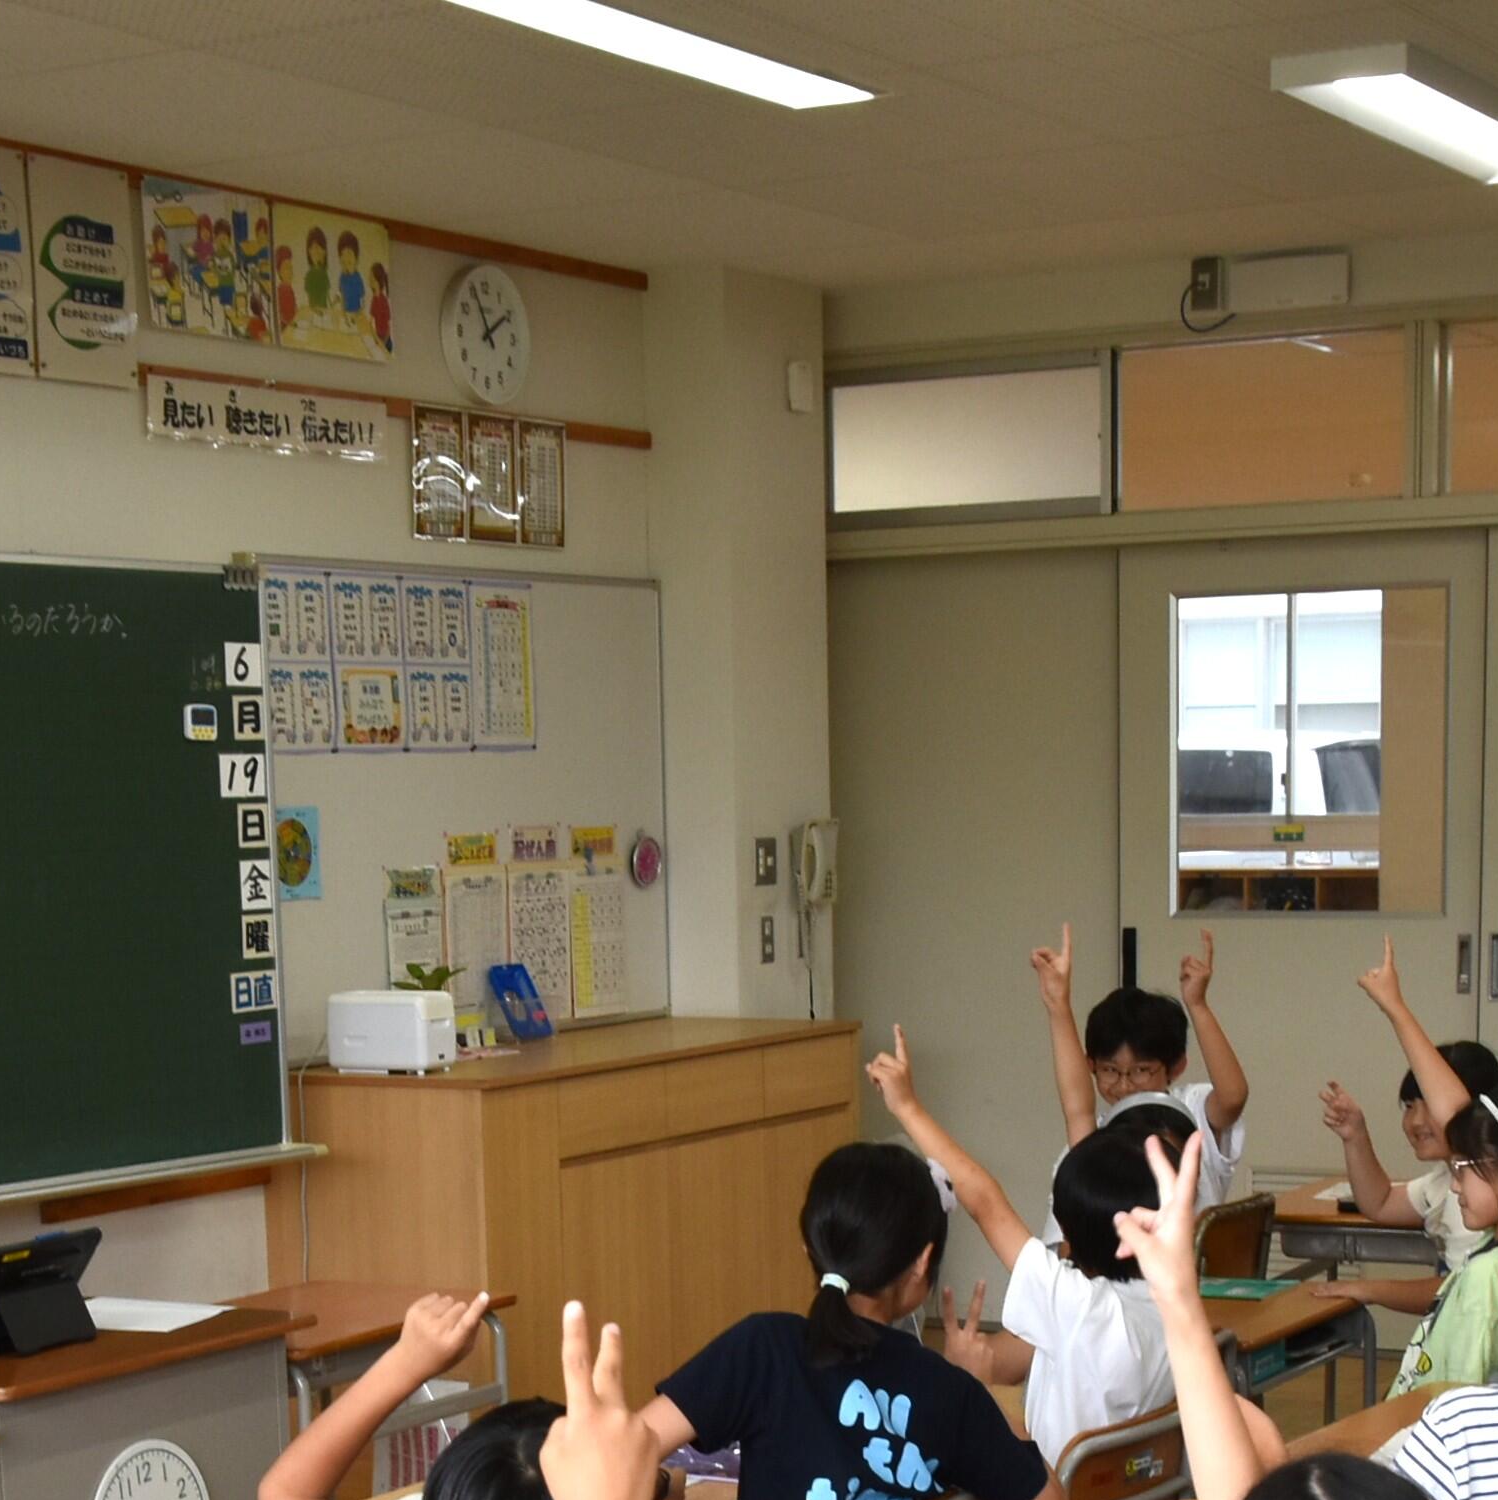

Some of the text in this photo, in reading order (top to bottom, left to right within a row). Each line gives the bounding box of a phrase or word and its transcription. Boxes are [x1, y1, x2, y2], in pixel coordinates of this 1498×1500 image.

[162, 399, 214, 429] 見たい
[225, 404, 292, 439] 聴きたい
[226, 646, 271, 954] 6 月 19 日 金 曜
[234, 974, 274, 1010] 日直
[838, 1378, 913, 1440] All
[136, 1462, 153, 1485] 12
[161, 1462, 168, 1482] 1
[861, 1436, 945, 1494] th
[118, 1477, 133, 1500] 11
[176, 1478, 188, 1500] 2
